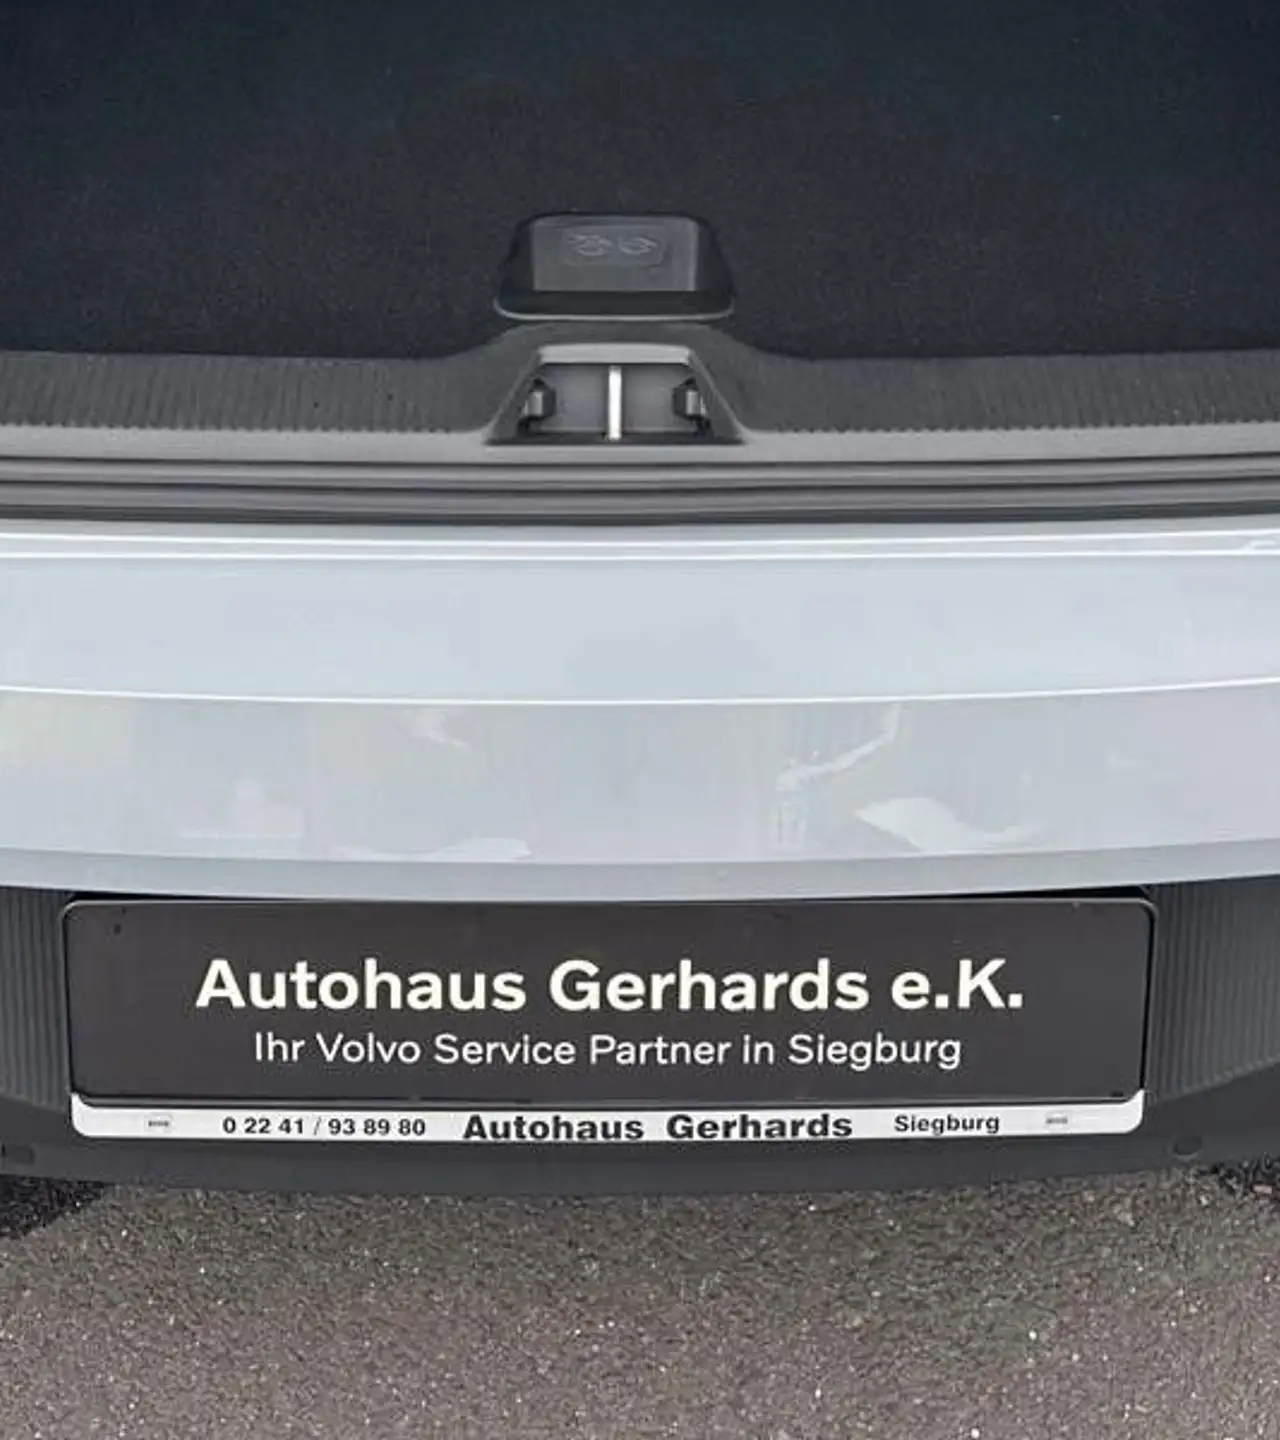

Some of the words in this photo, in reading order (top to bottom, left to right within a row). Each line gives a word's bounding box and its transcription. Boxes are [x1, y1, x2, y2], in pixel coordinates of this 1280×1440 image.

[196, 957, 526, 1012] Autohaus
[550, 957, 869, 1012] Gerhards
[892, 958, 1024, 1010] e.K.
[256, 1031, 305, 1063] Ihr
[316, 1031, 422, 1064] Volvo
[434, 1032, 576, 1065] Service
[590, 1034, 733, 1065] Partner
[743, 1033, 774, 1065] in
[788, 1031, 962, 1072] Siegburg
[223, 1117, 236, 1134] 0
[244, 1117, 271, 1135] 22
[278, 1118, 304, 1135] 41
[328, 1118, 356, 1136] 93
[363, 1118, 391, 1136] 89
[398, 1118, 426, 1136] 80
[462, 1113, 645, 1140] Autohaus
[666, 1112, 853, 1139] Gerhards
[893, 1113, 1001, 1135] Siegburg
